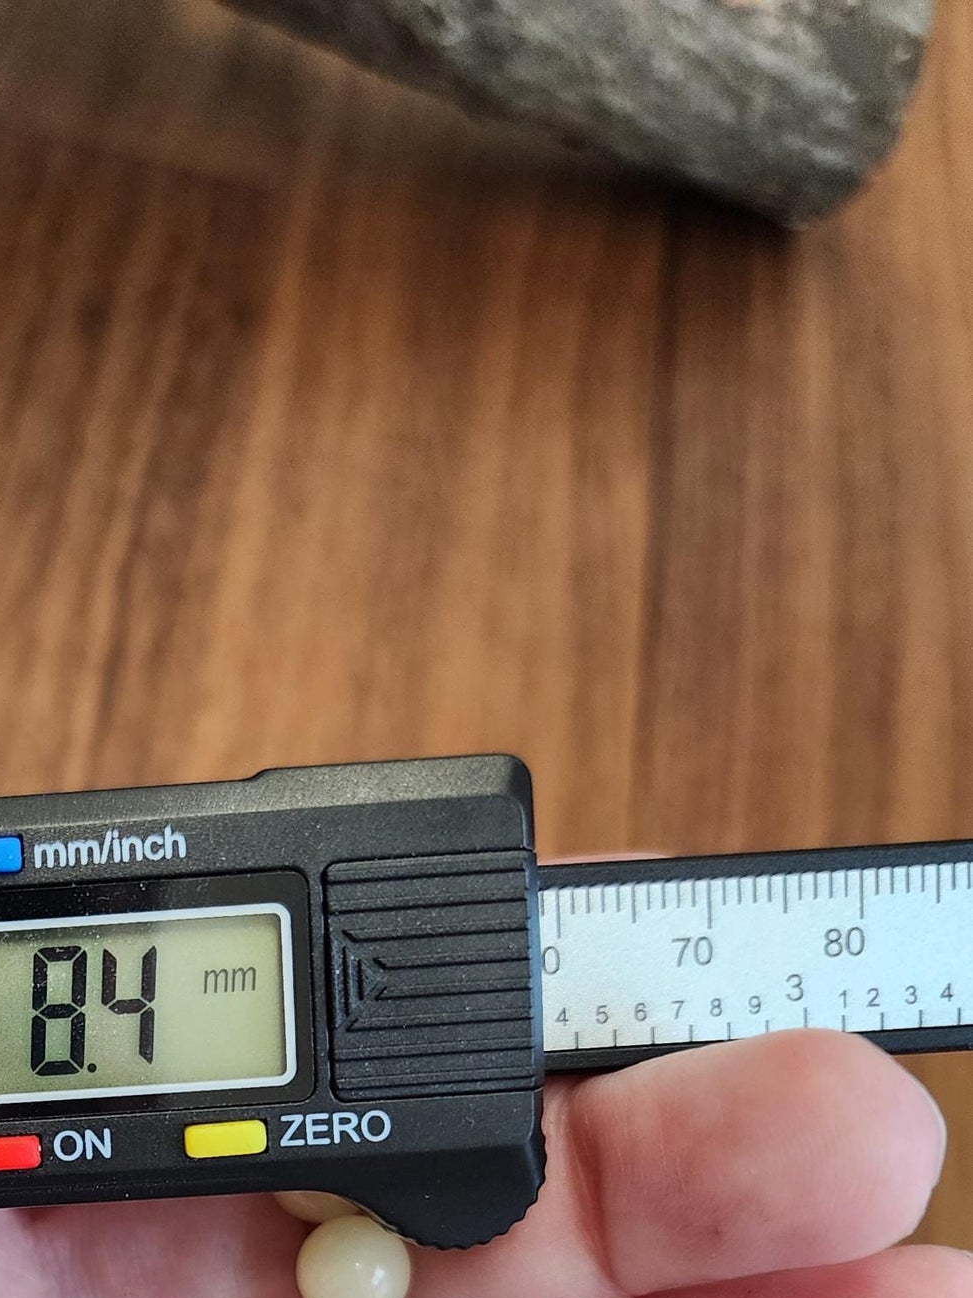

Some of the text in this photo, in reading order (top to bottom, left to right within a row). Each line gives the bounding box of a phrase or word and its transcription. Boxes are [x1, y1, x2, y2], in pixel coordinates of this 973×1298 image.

[33, 825, 187, 870] mm/inch
[542, 926, 865, 974] 0 70 80
[30, 944, 258, 1077] 8.4 mm
[556, 975, 953, 1025] 4 5 6 7 8 9 3 1 2 3 4
[53, 1127, 113, 1161] ON
[279, 1109, 392, 1149] ZERO
